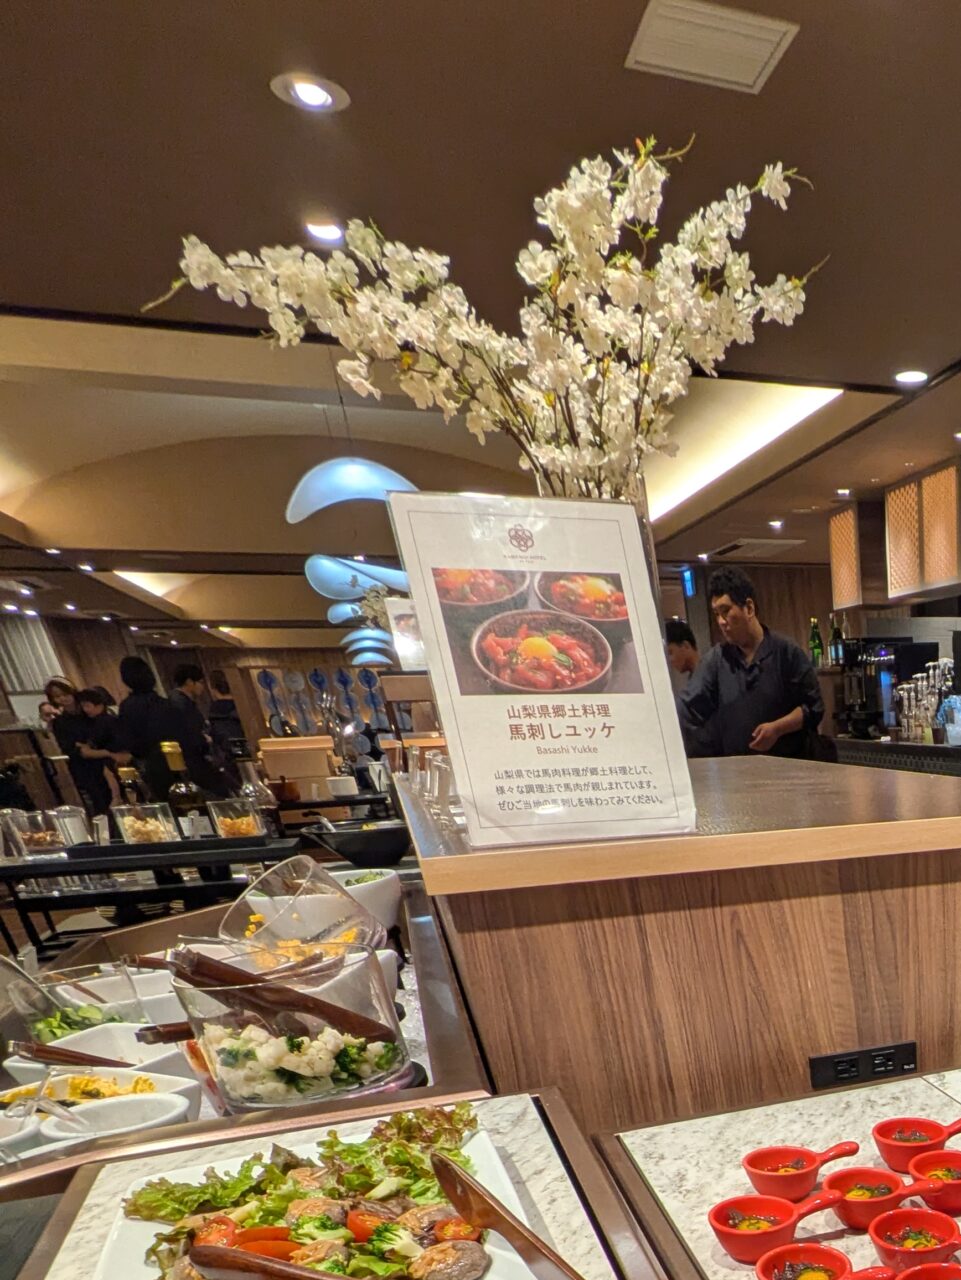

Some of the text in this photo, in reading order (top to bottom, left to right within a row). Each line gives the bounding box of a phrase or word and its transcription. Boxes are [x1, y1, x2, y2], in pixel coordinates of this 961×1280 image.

[507, 703, 612, 720] 山梨県郷土料理
[509, 722, 616, 741] 馬刺しユッケ
[536, 746, 598, 755] Basashi Yukke
